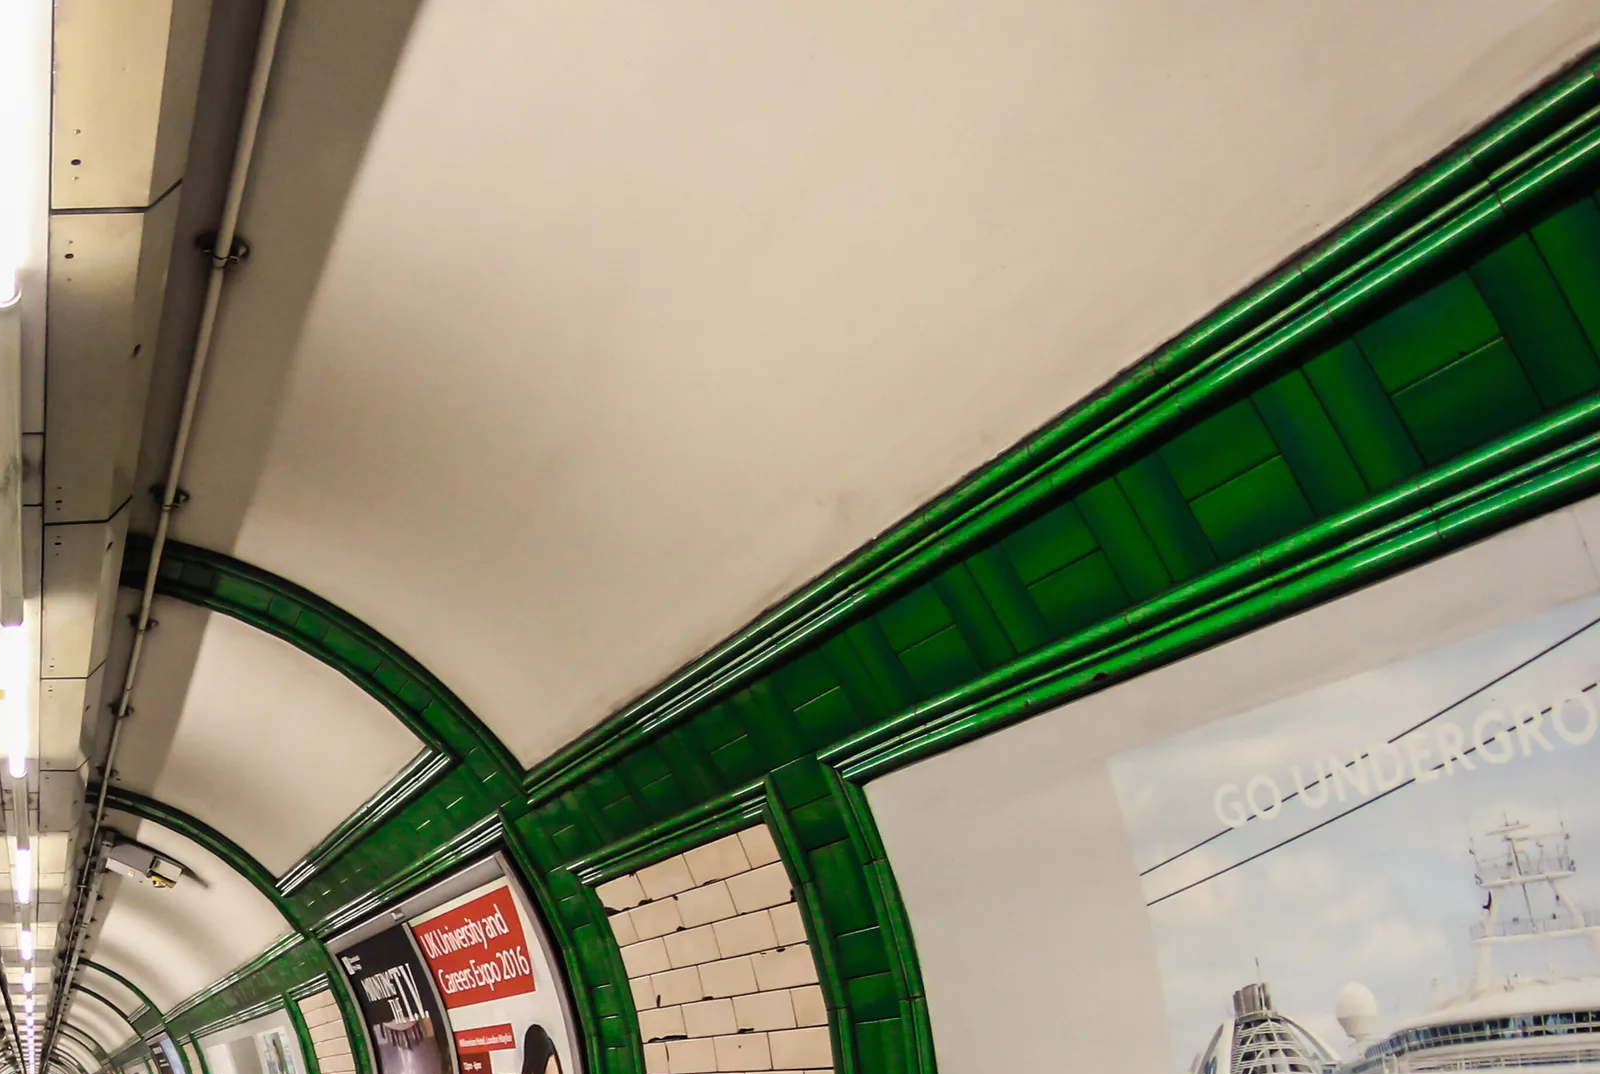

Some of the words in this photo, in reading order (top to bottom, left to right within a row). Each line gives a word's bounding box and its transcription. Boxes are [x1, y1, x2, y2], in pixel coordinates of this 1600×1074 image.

[1213, 773, 1283, 828] GO
[420, 931, 443, 959] UK
[434, 918, 488, 956] University
[481, 903, 510, 939] and
[438, 967, 477, 994] Careers
[469, 959, 502, 992] Expo
[495, 945, 530, 981] 2016
